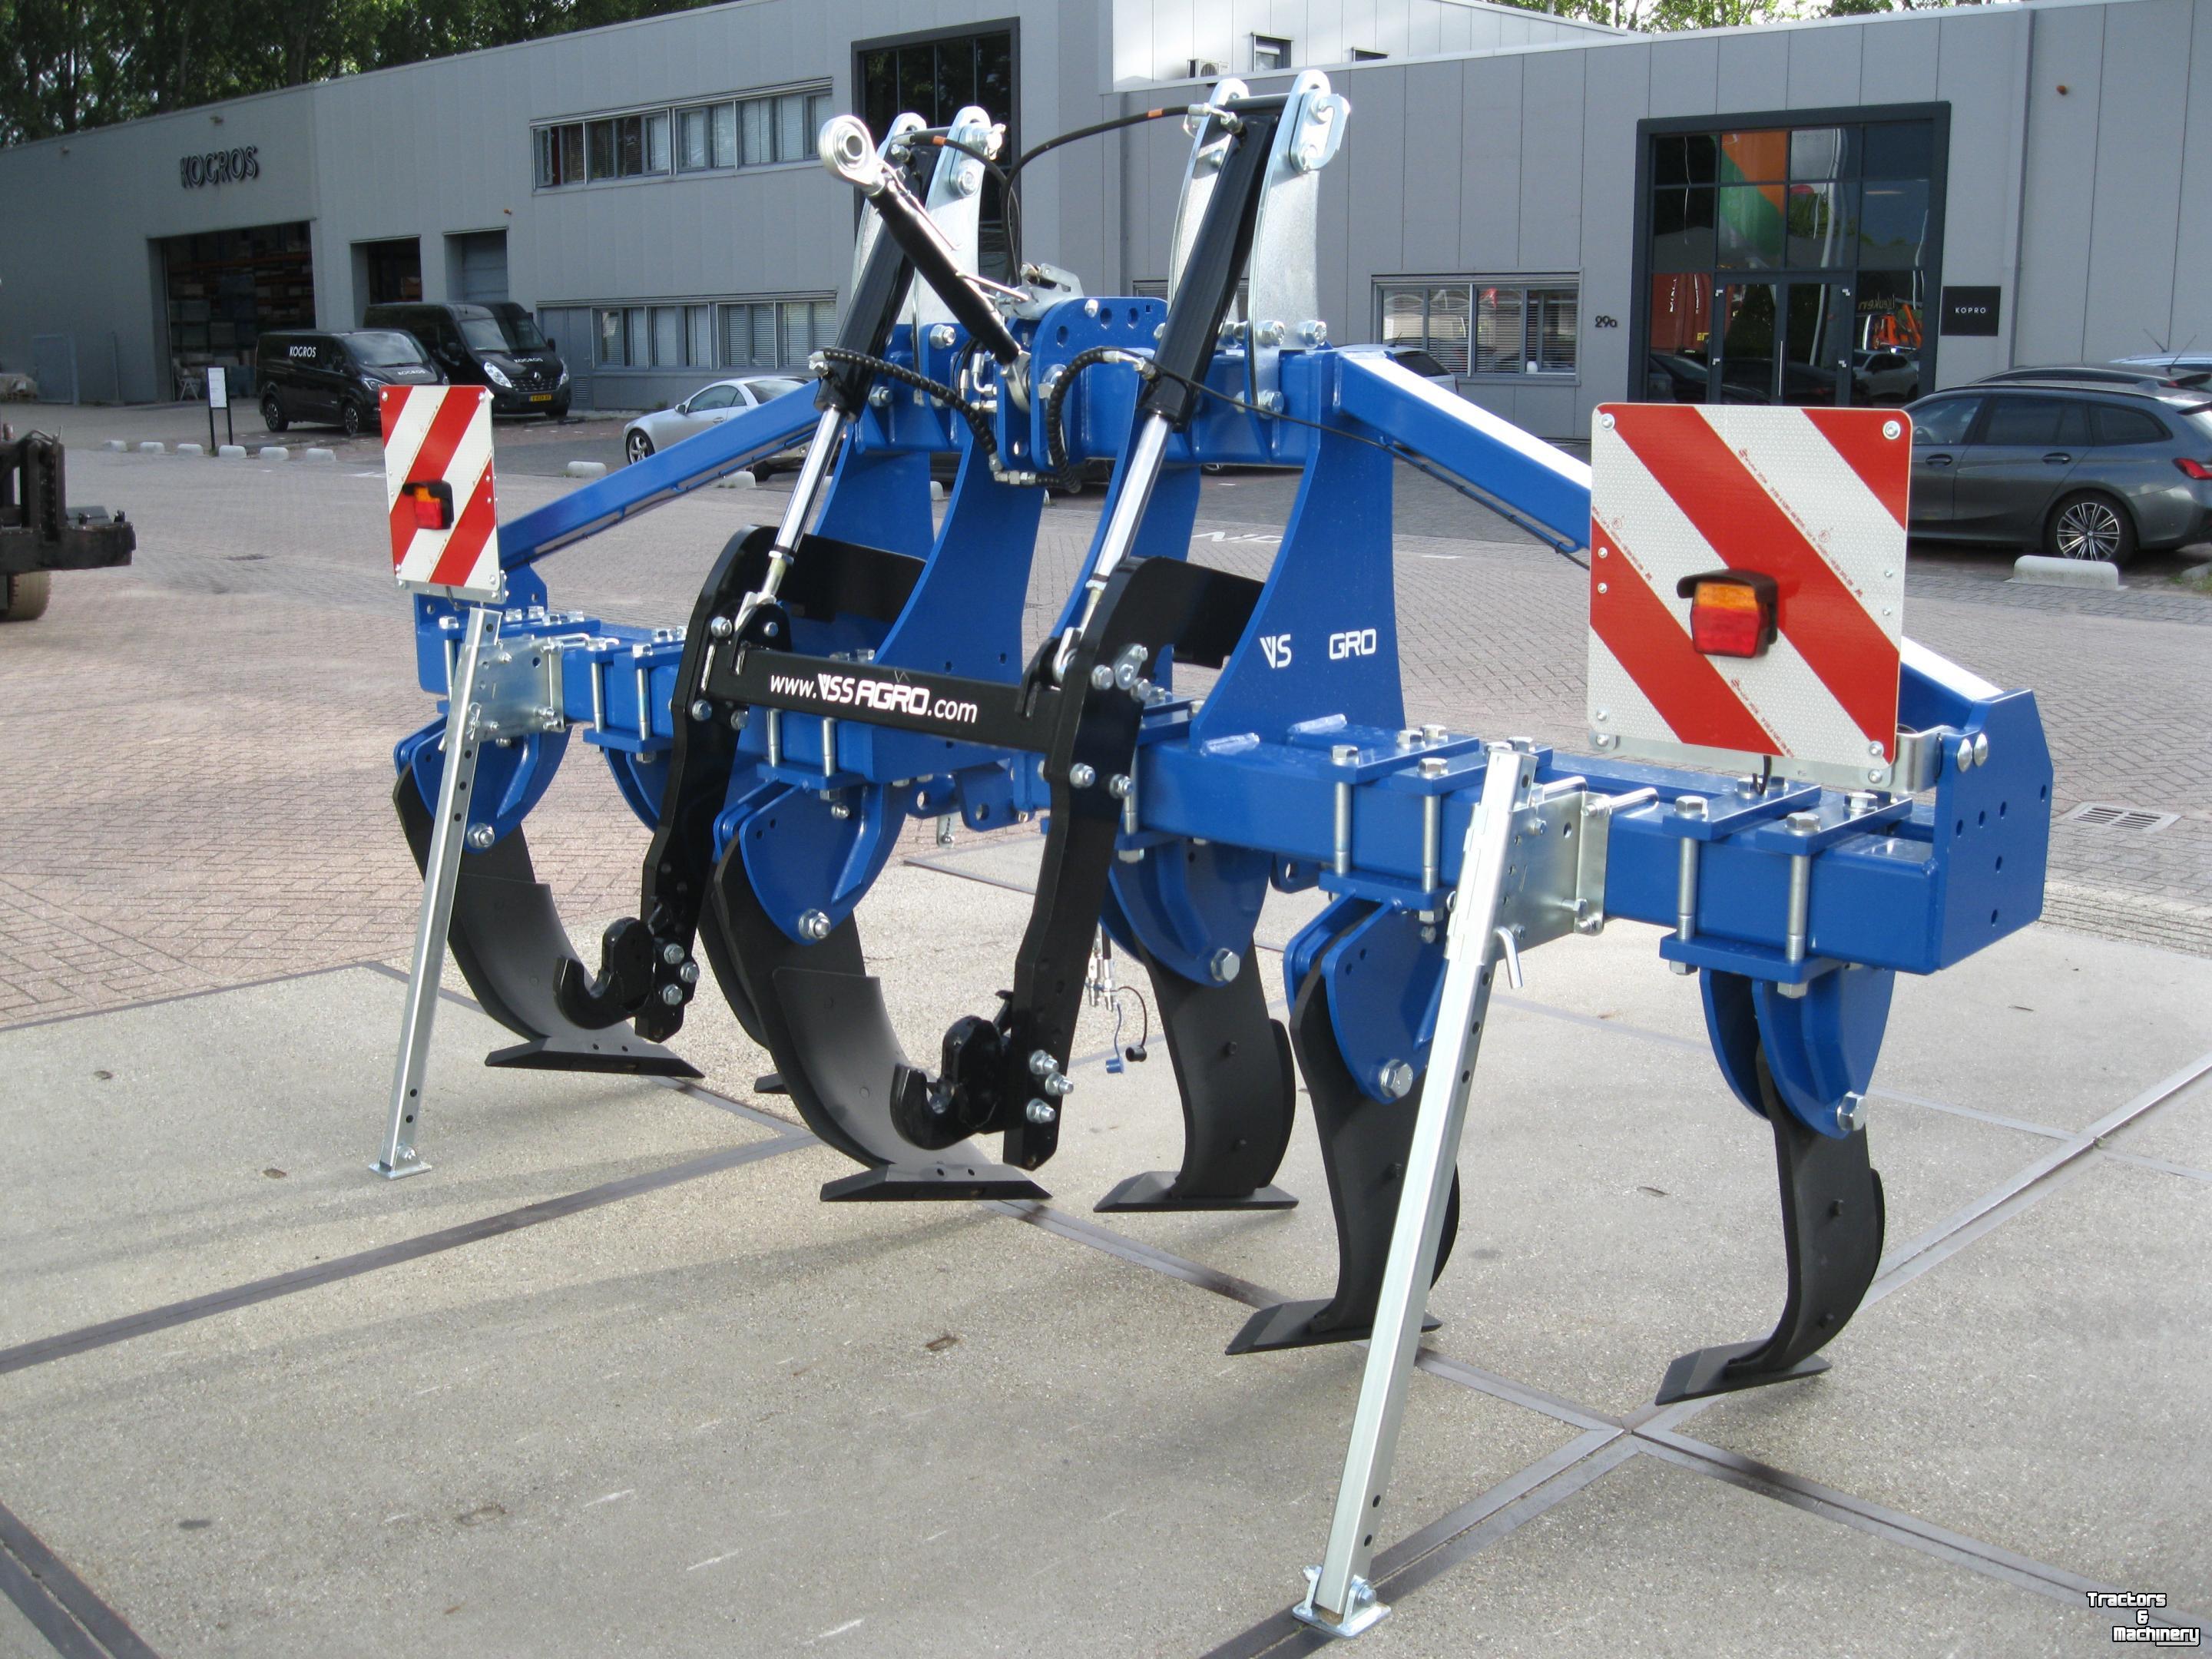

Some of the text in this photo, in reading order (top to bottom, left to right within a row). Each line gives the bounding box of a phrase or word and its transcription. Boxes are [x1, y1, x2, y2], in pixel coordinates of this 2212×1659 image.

[180, 145, 259, 188] KOGROS
[1595, 316, 1617, 328] 29a
[290, 346, 316, 358] KOGROS
[1330, 628, 1376, 660] GRO
